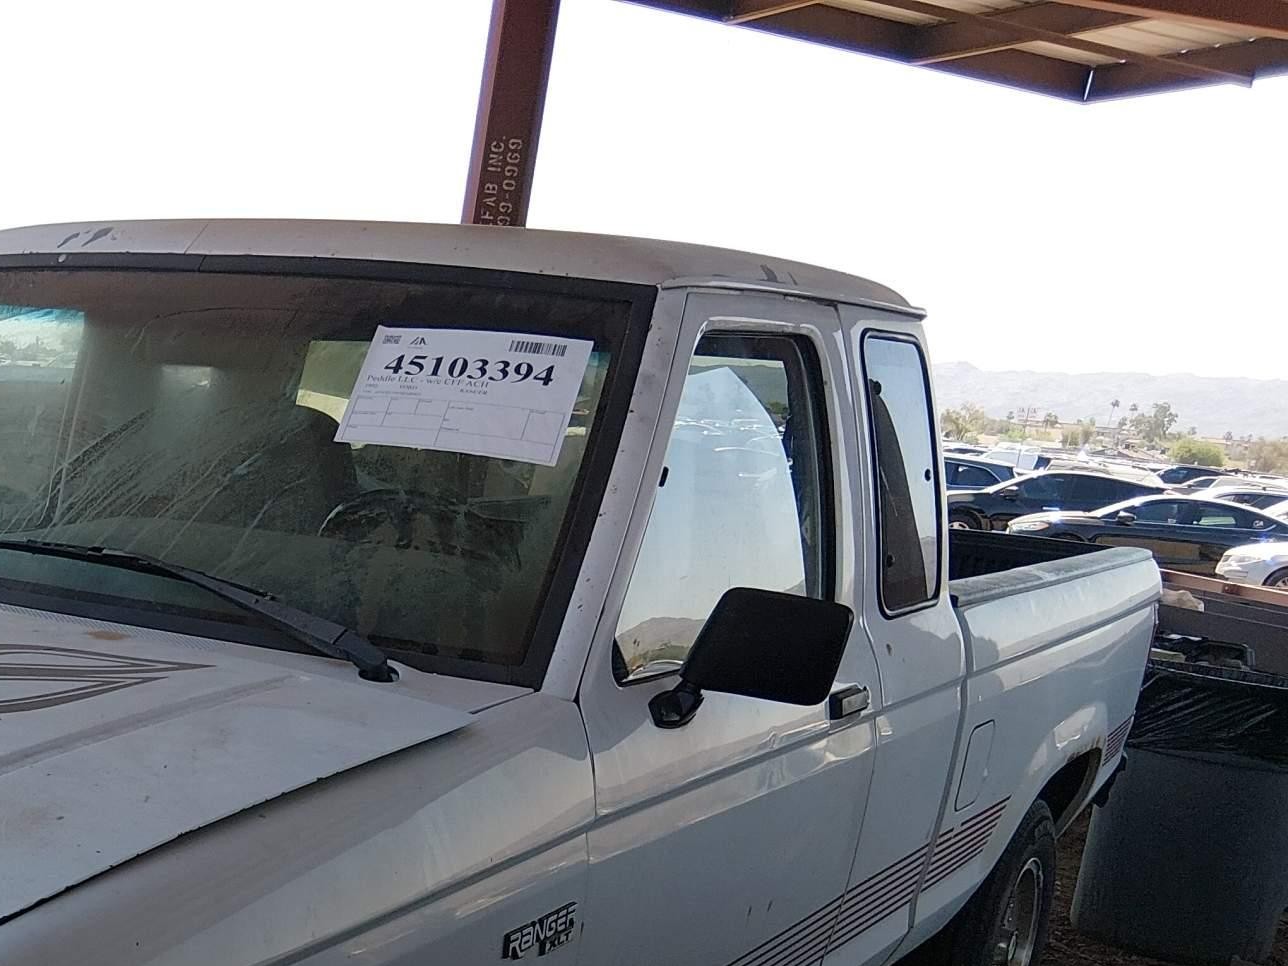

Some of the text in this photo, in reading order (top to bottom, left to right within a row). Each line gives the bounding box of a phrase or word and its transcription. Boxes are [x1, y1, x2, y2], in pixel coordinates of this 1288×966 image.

[478, 136, 506, 226] FAB INC.
[384, 354, 555, 386] 45103394
[398, 375, 416, 384] LLC
[501, 901, 578, 960] RANGER
